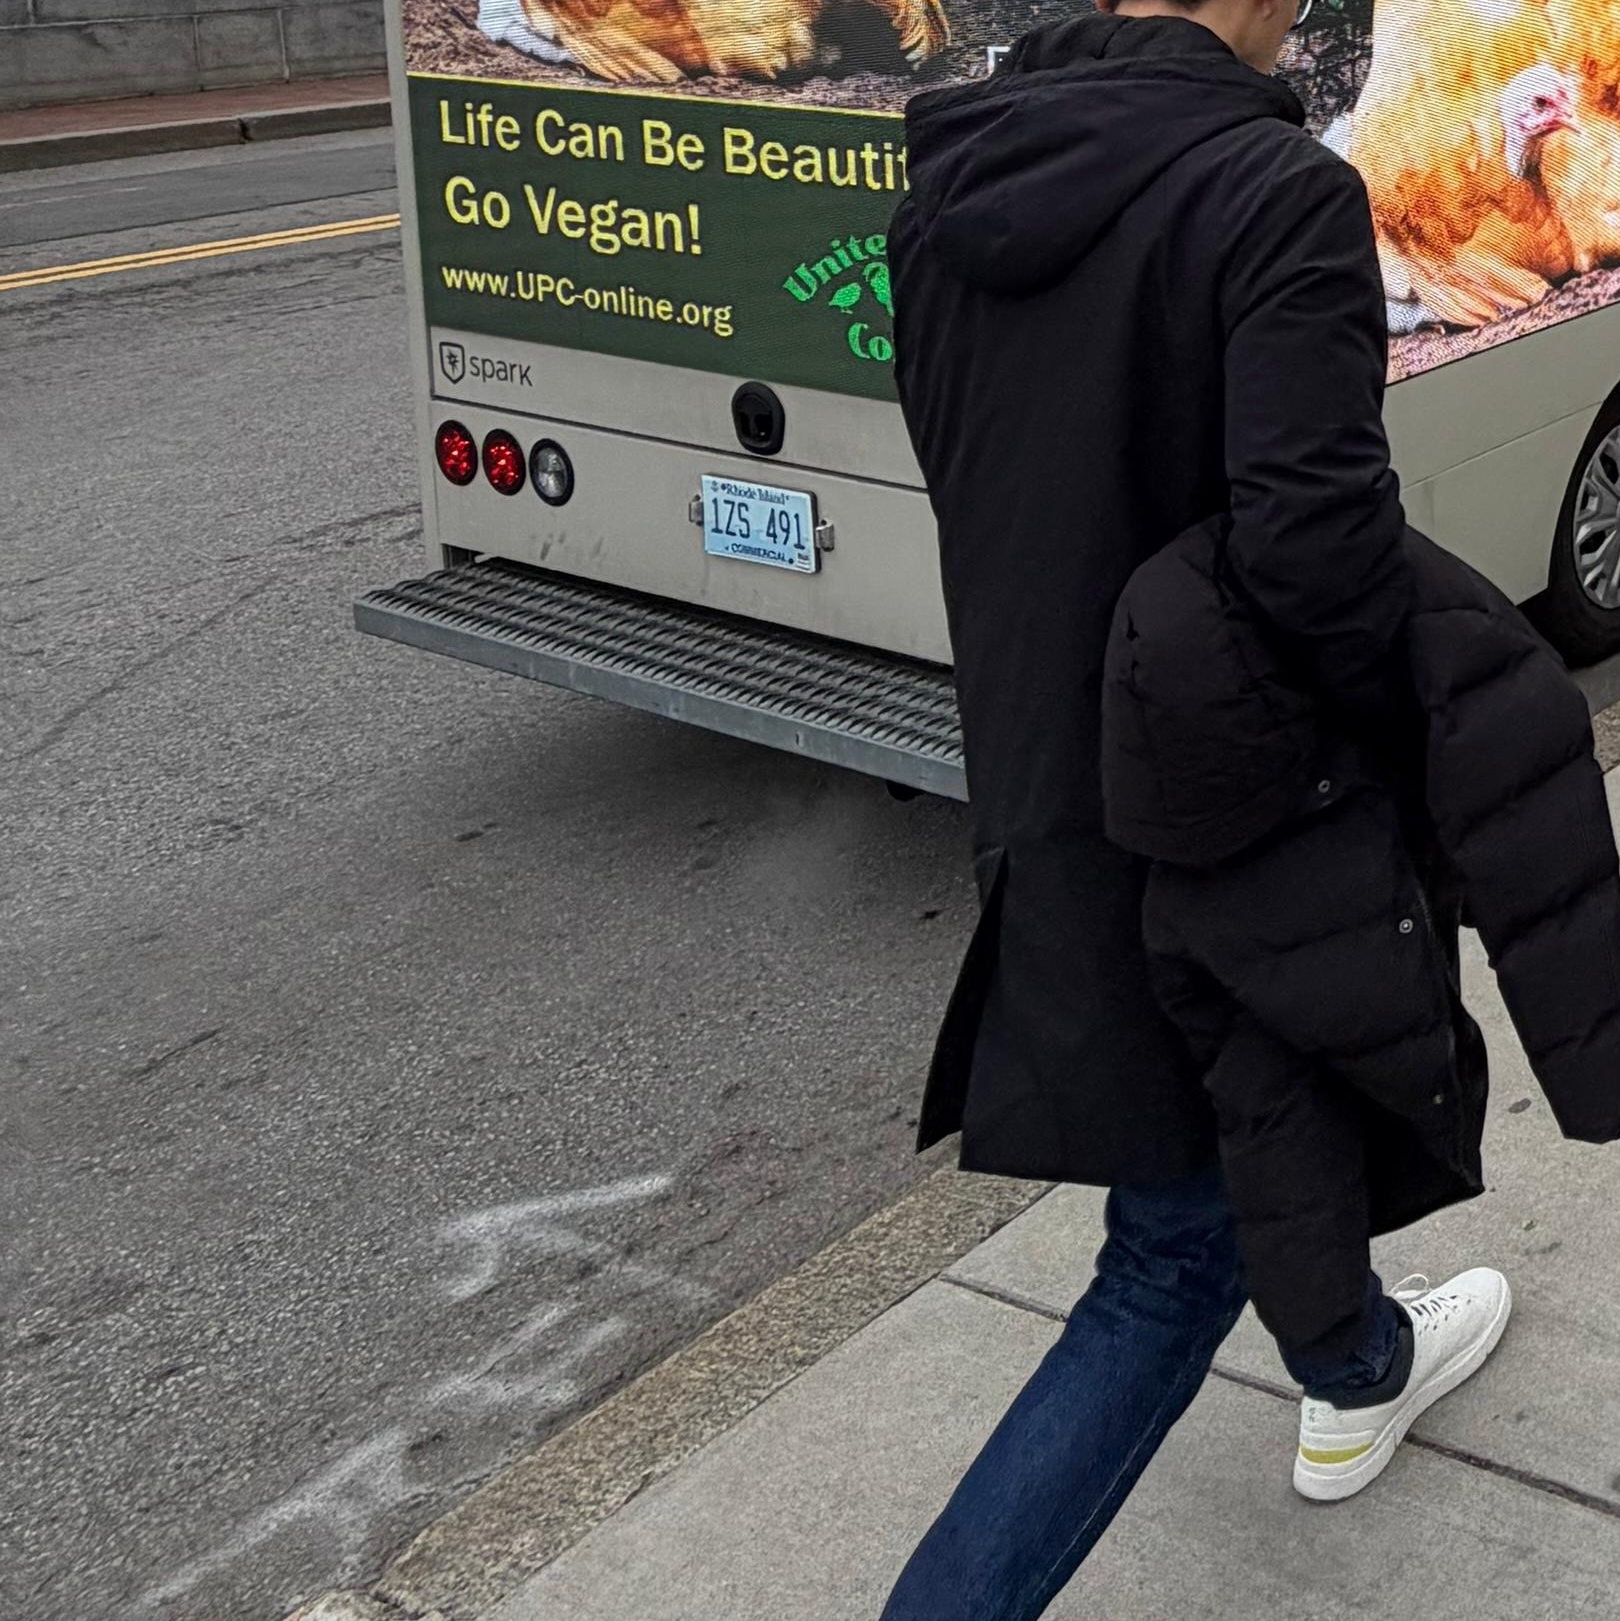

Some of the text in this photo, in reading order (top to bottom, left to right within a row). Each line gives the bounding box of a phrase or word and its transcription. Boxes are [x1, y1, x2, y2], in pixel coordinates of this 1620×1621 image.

[439, 99, 910, 191] Life Can Be Beauti
[445, 175, 702, 255] Go Vegan!
[441, 265, 734, 337] www.UPC-online.org
[783, 234, 887, 301] Unite
[469, 354, 533, 387] spark
[711, 497, 806, 550] 1ZS 491
[724, 483, 757, 500] Rhode
